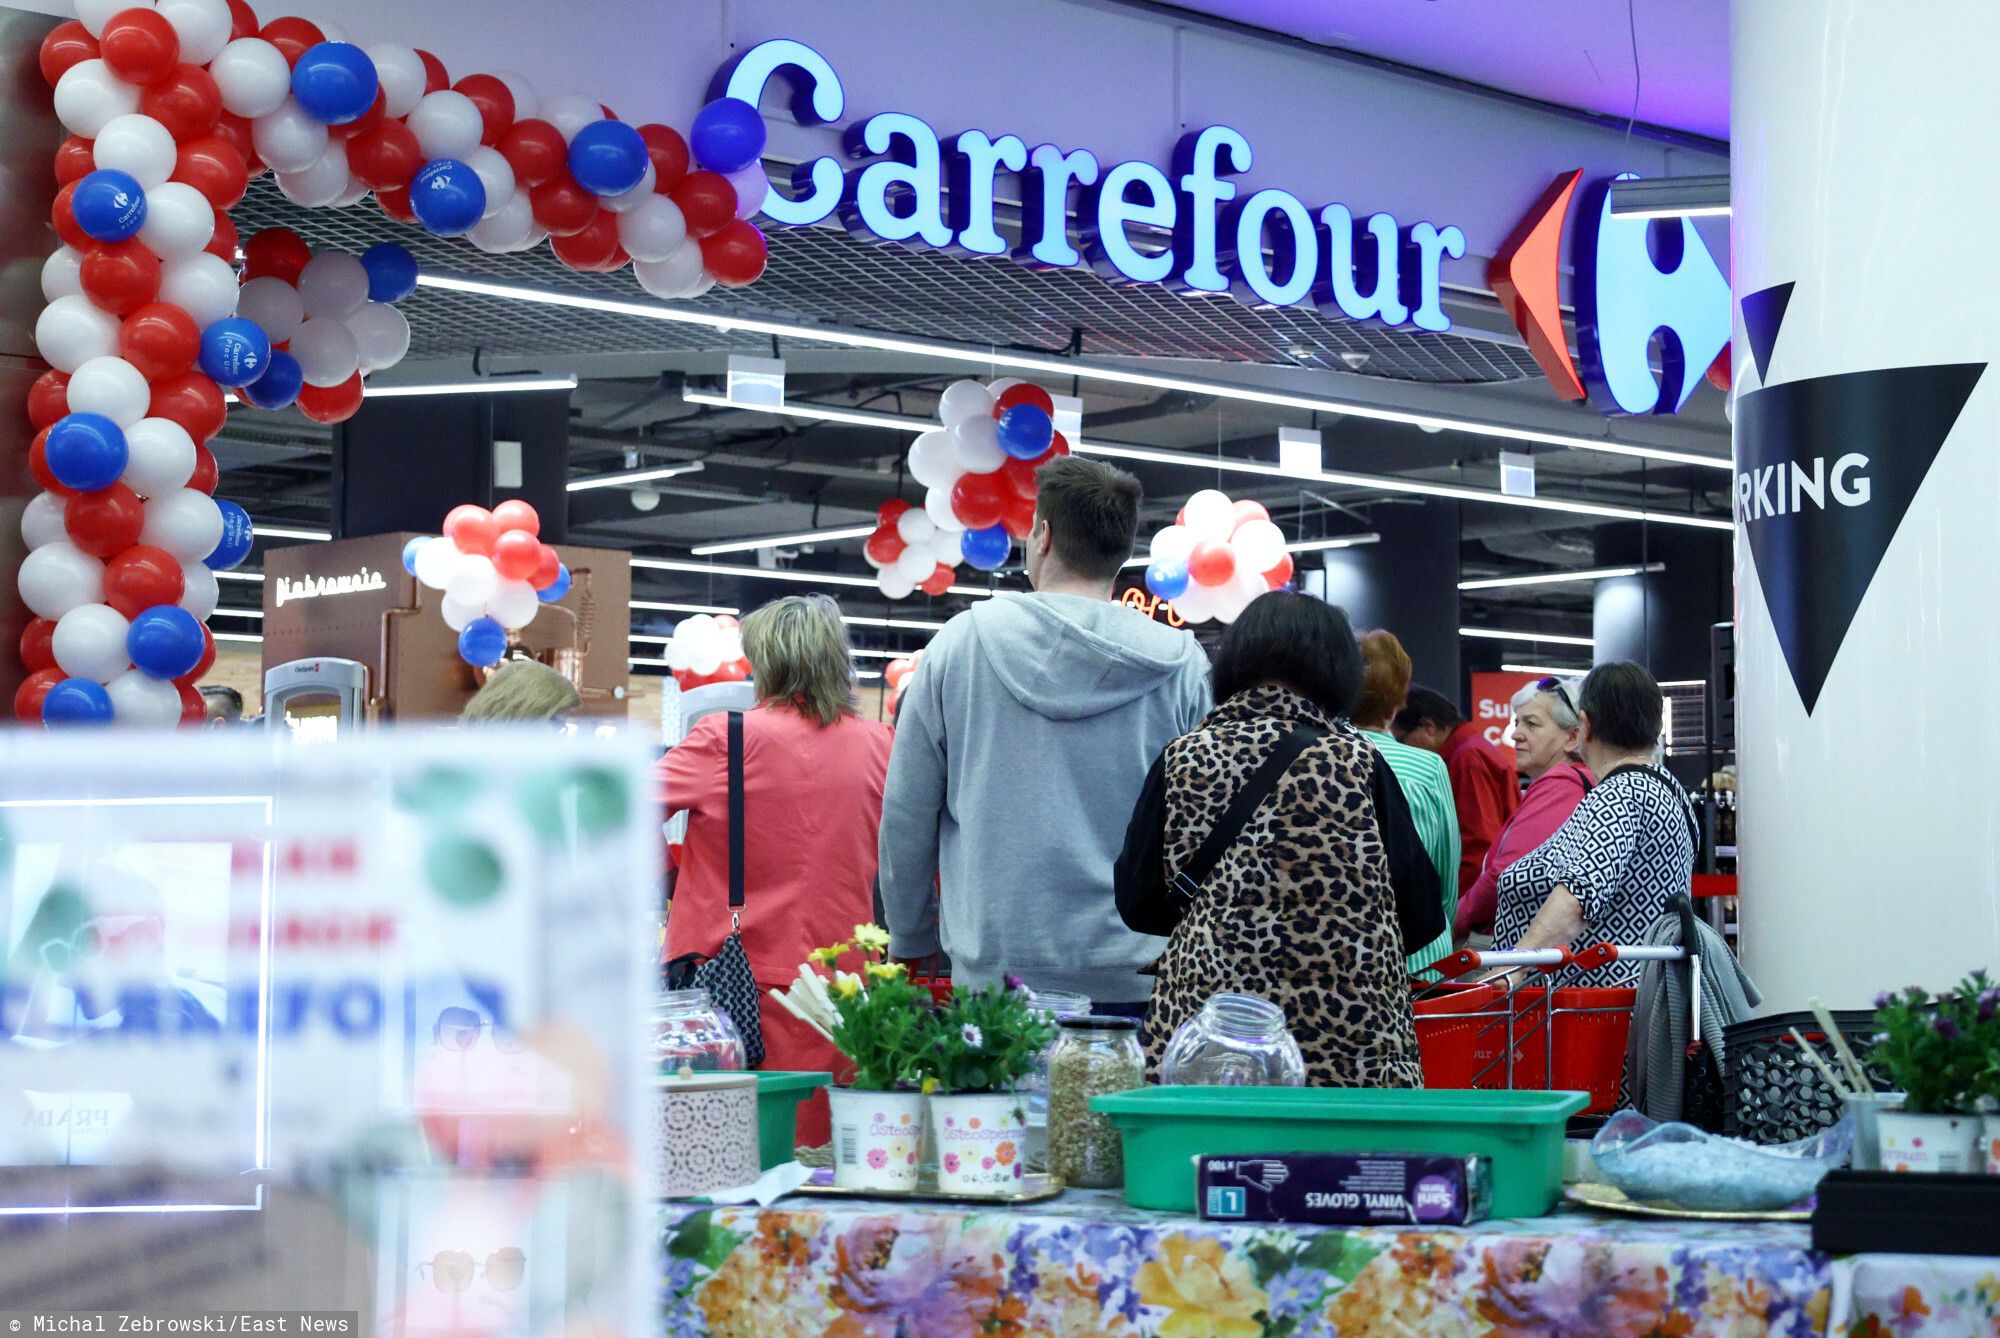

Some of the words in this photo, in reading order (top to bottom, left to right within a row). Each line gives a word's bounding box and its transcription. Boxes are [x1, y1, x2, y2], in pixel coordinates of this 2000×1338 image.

[725, 38, 1466, 333] Carrefour
[118, 195, 141, 224] Carrefour
[232, 342, 242, 375] Carrefour
[1478, 698, 1511, 719] Su
[1304, 1192, 1360, 1209] GLOVES
[1362, 1193, 1405, 1208] VINYL
